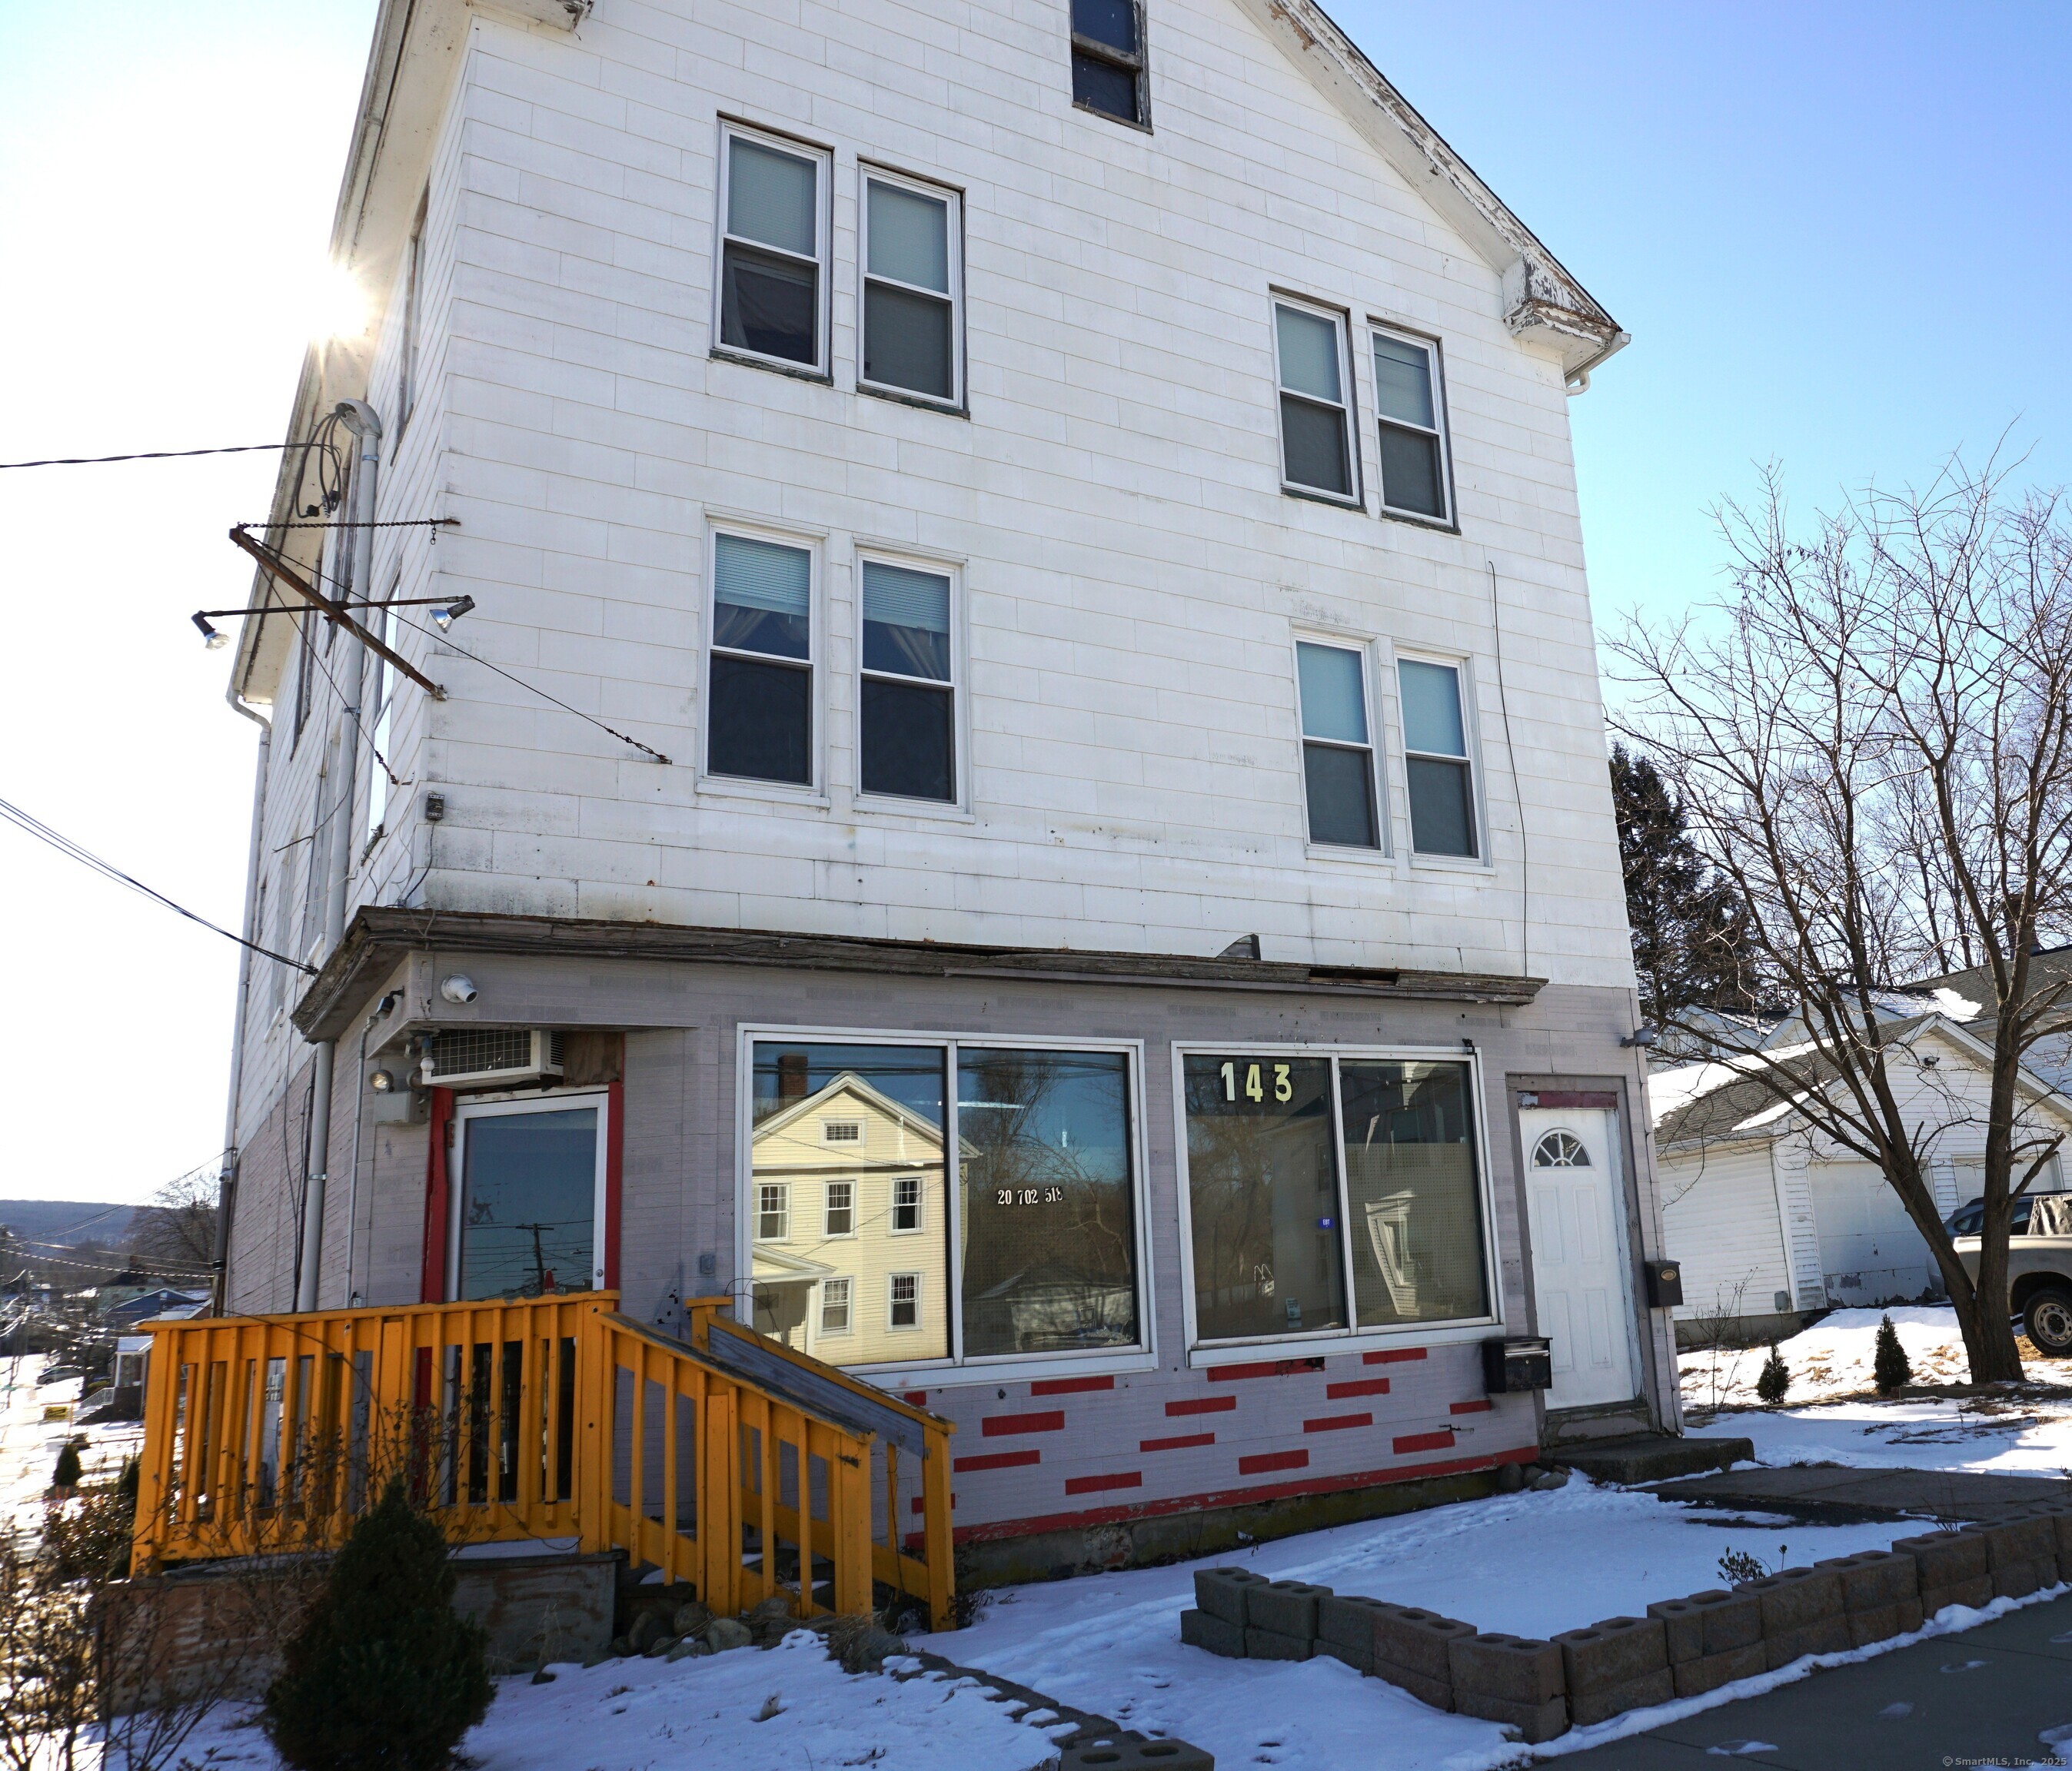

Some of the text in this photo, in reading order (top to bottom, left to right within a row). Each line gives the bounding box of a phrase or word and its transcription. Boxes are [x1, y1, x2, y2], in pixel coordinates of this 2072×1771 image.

[1221, 1062, 1292, 1102] 143
[997, 1186, 1063, 1205] 20 702 518
